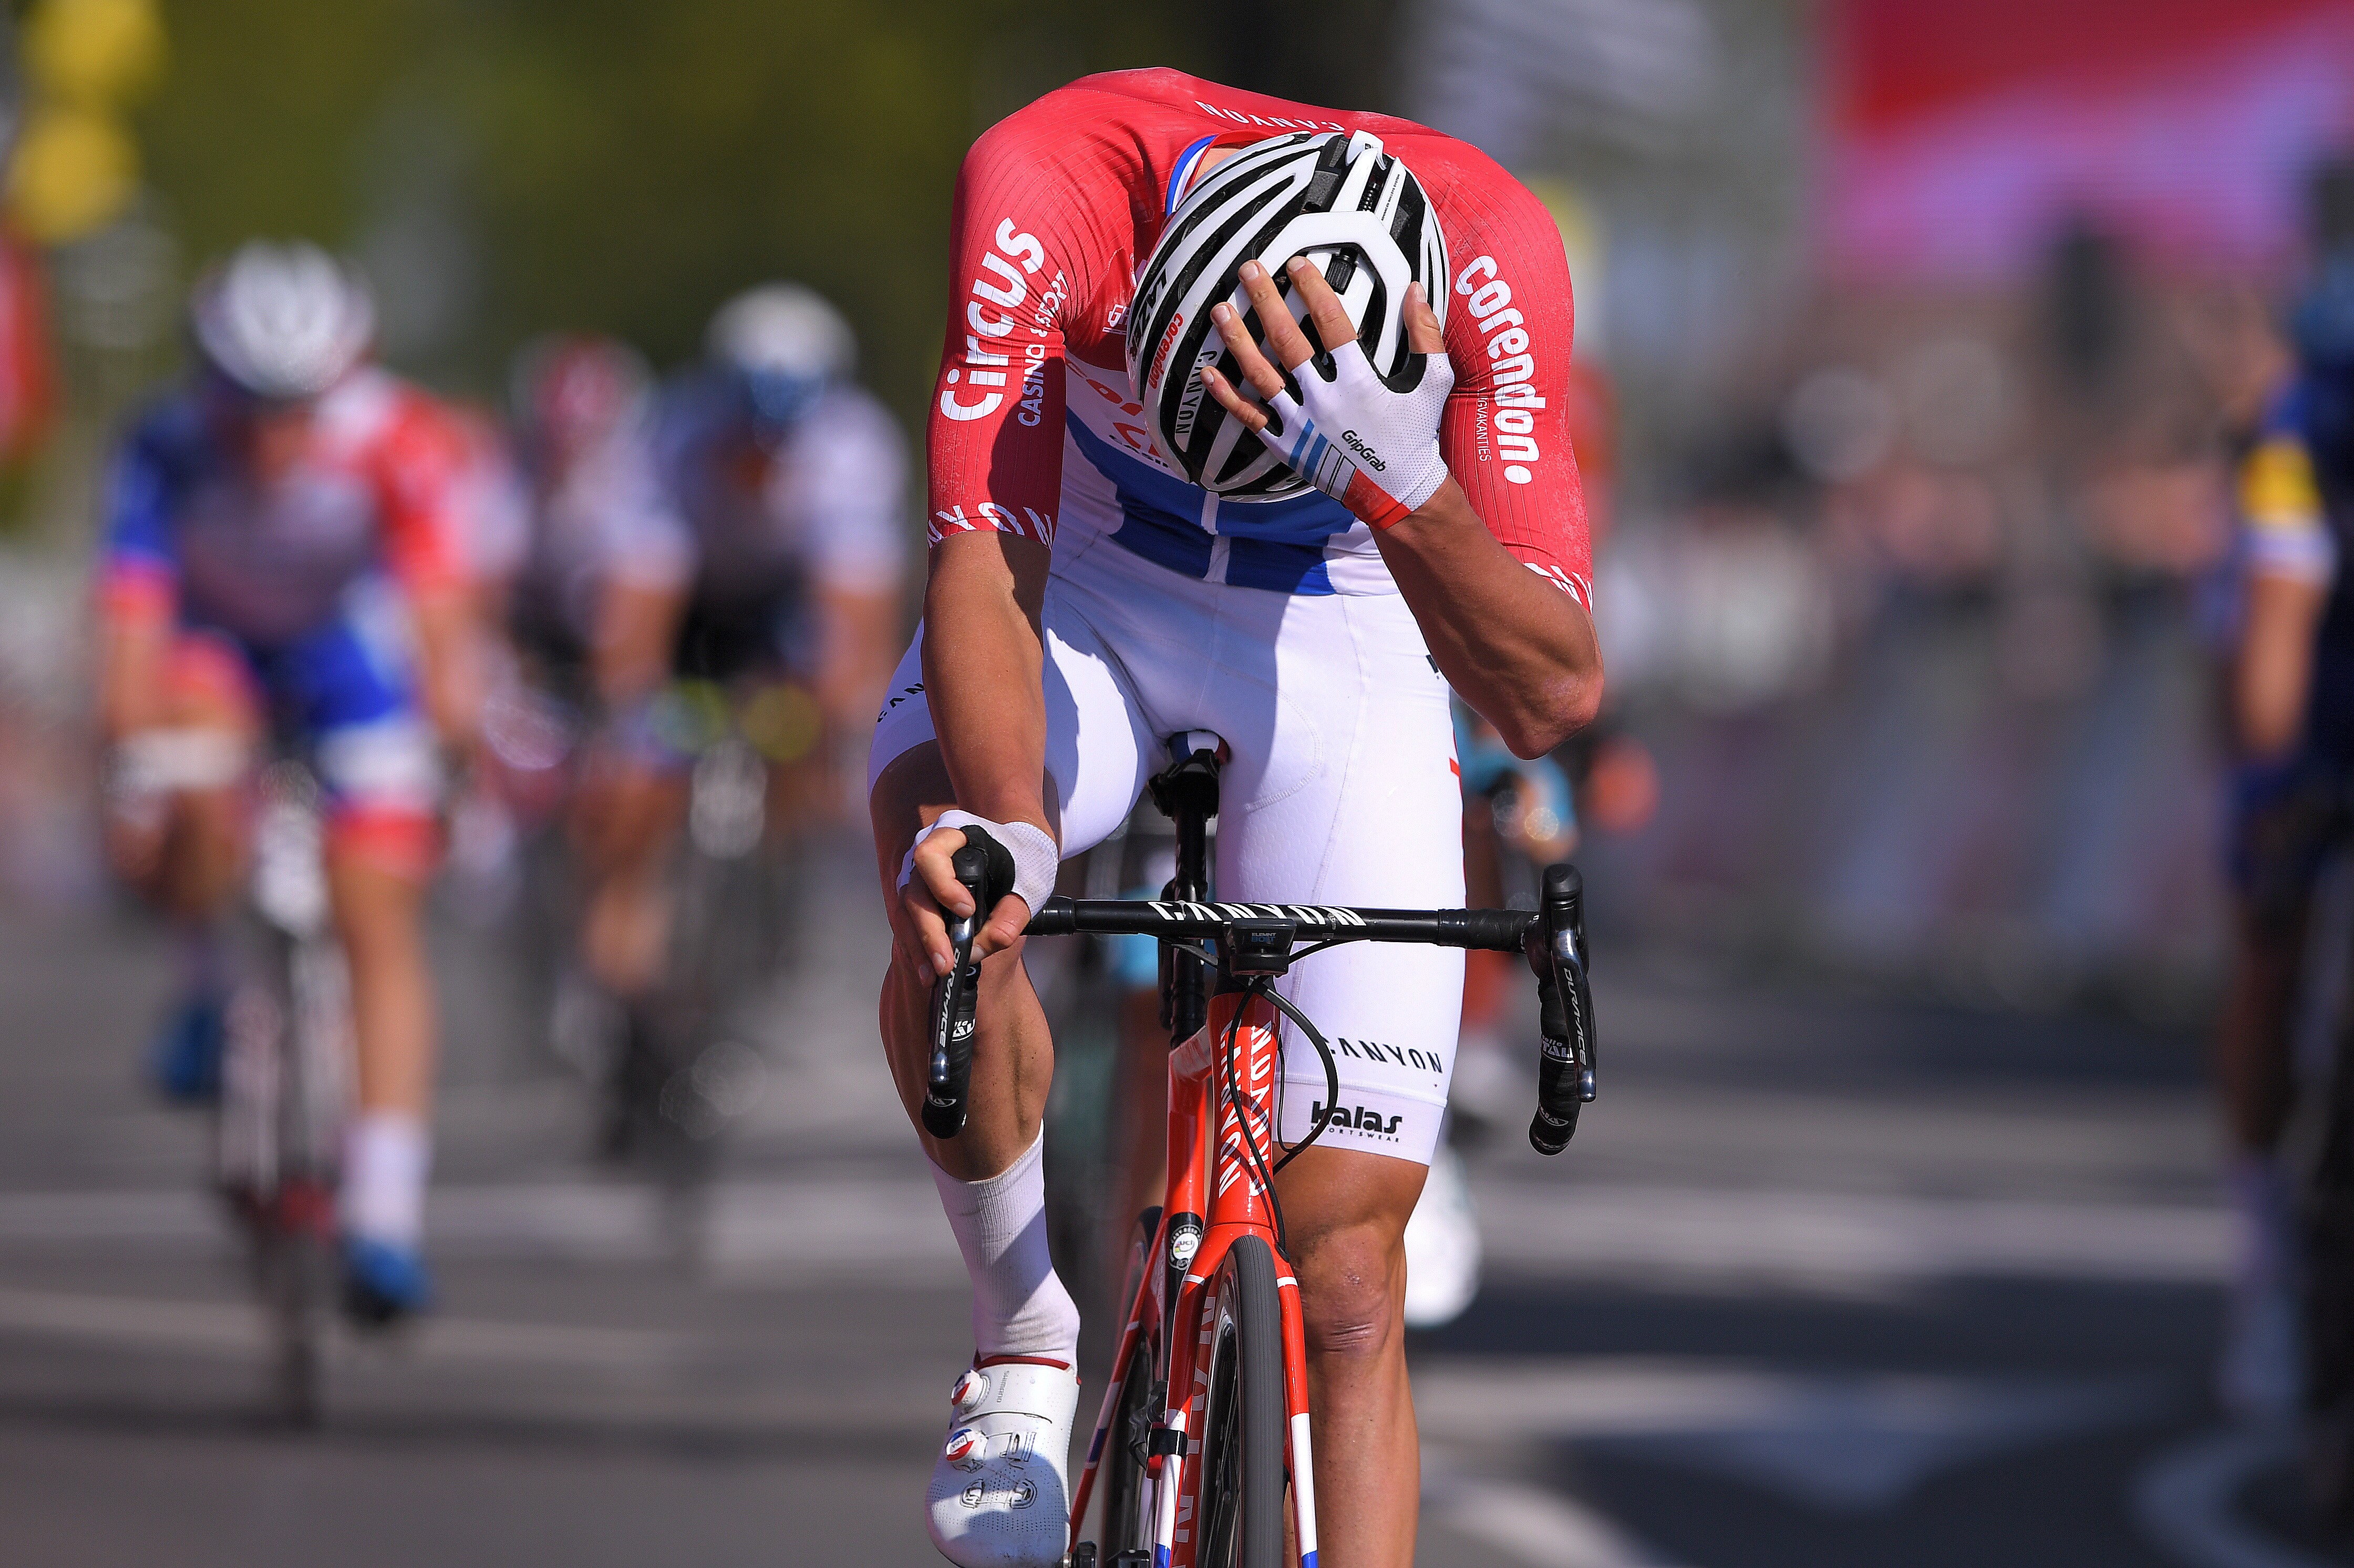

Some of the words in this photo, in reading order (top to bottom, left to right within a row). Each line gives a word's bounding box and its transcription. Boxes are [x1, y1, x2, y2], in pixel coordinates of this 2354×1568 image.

[1194, 100, 1345, 131] CANYON
[940, 217, 1044, 421] Circus
[1030, 327, 1048, 338] &
[1129, 268, 1168, 362] LAZER
[1149, 313, 1184, 389] corendon
[1018, 344, 1045, 426] CASINO
[1341, 430, 1386, 471] GripGrab
[1148, 901, 1367, 926] CANYON
[1563, 967, 1587, 1066] DURA-ACE
[1321, 1037, 1443, 1073] ANYON
[1310, 1126, 1400, 1142] SORTSWEAR
[1311, 1101, 1403, 1134] kalas
